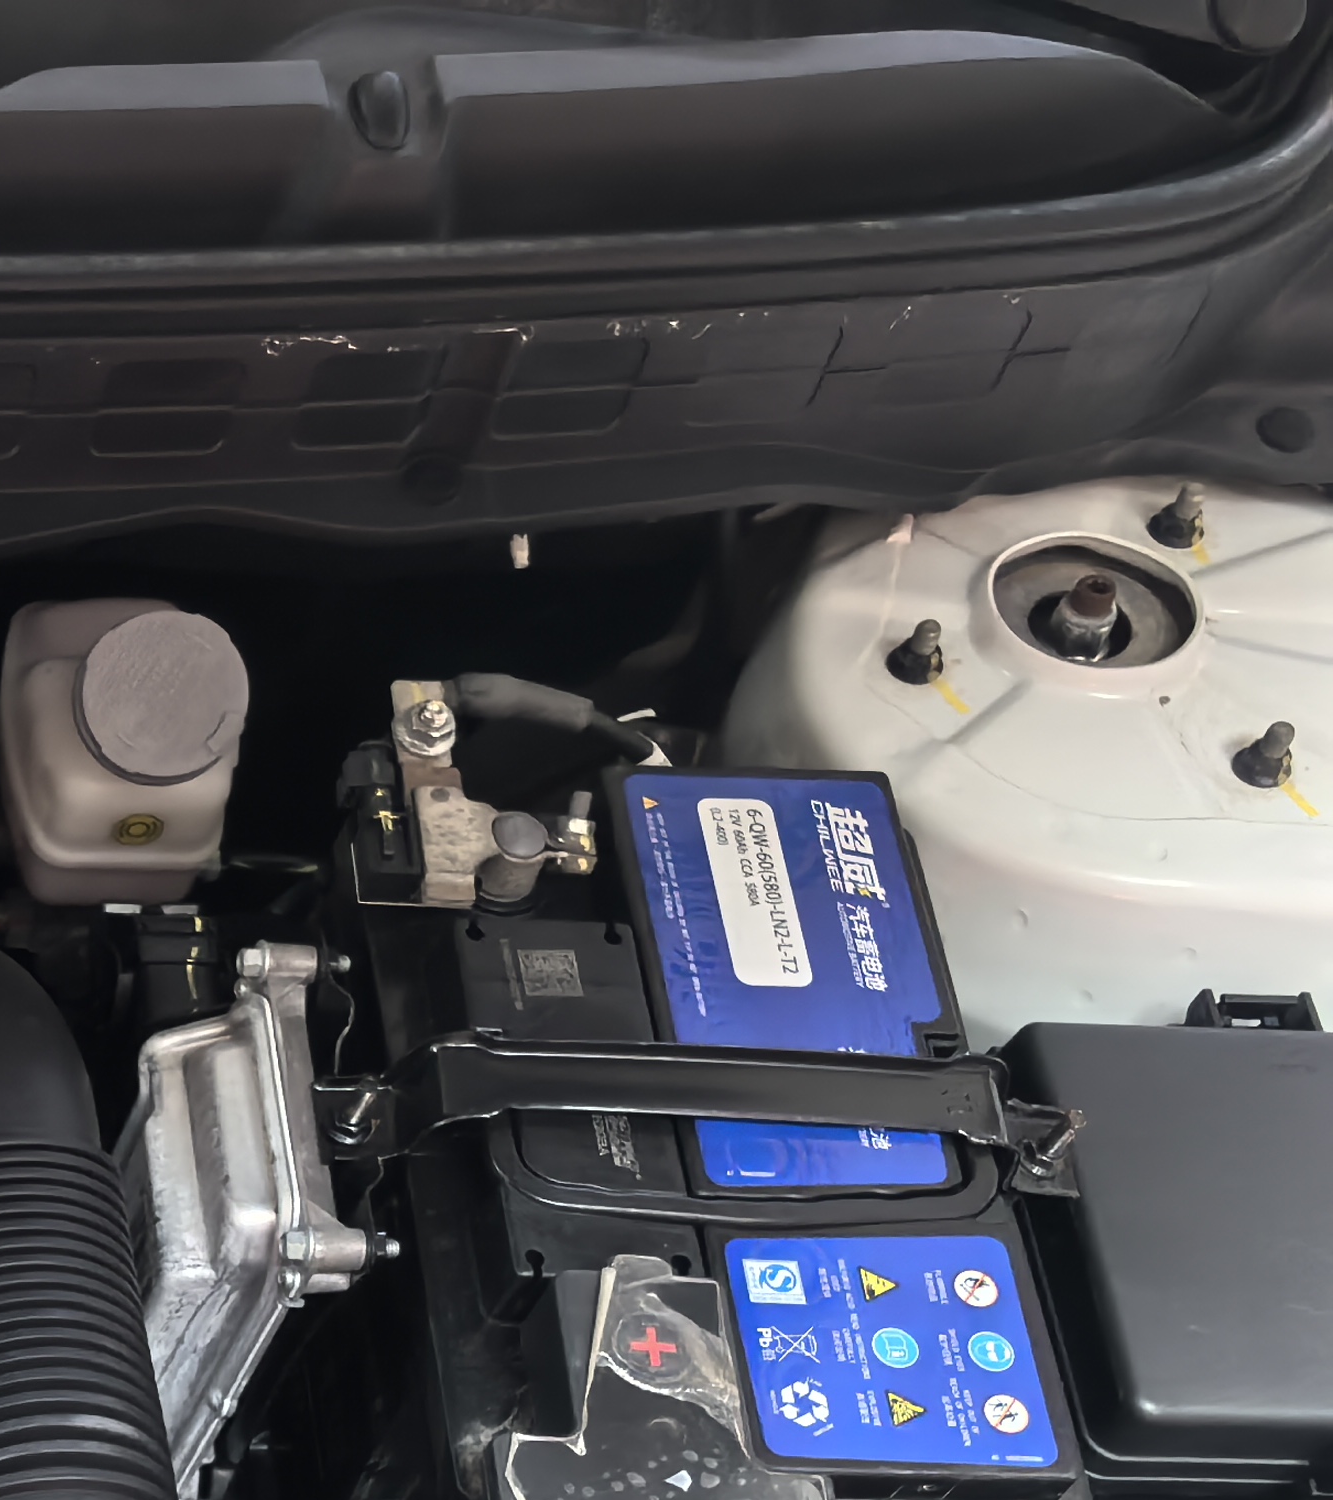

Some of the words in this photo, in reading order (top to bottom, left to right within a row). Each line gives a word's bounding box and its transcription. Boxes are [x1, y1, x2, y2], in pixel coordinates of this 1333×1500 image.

[728, 809, 742, 829] 12V
[739, 858, 753, 878] CCA
[811, 800, 845, 893] CHILWEE
[825, 801, 887, 901] 超威
[747, 808, 799, 974] 6-QW-60(580)-LN2-L-T2
[845, 903, 888, 992] 汽车蓄电池
[756, 1326, 772, 1348] Pb
